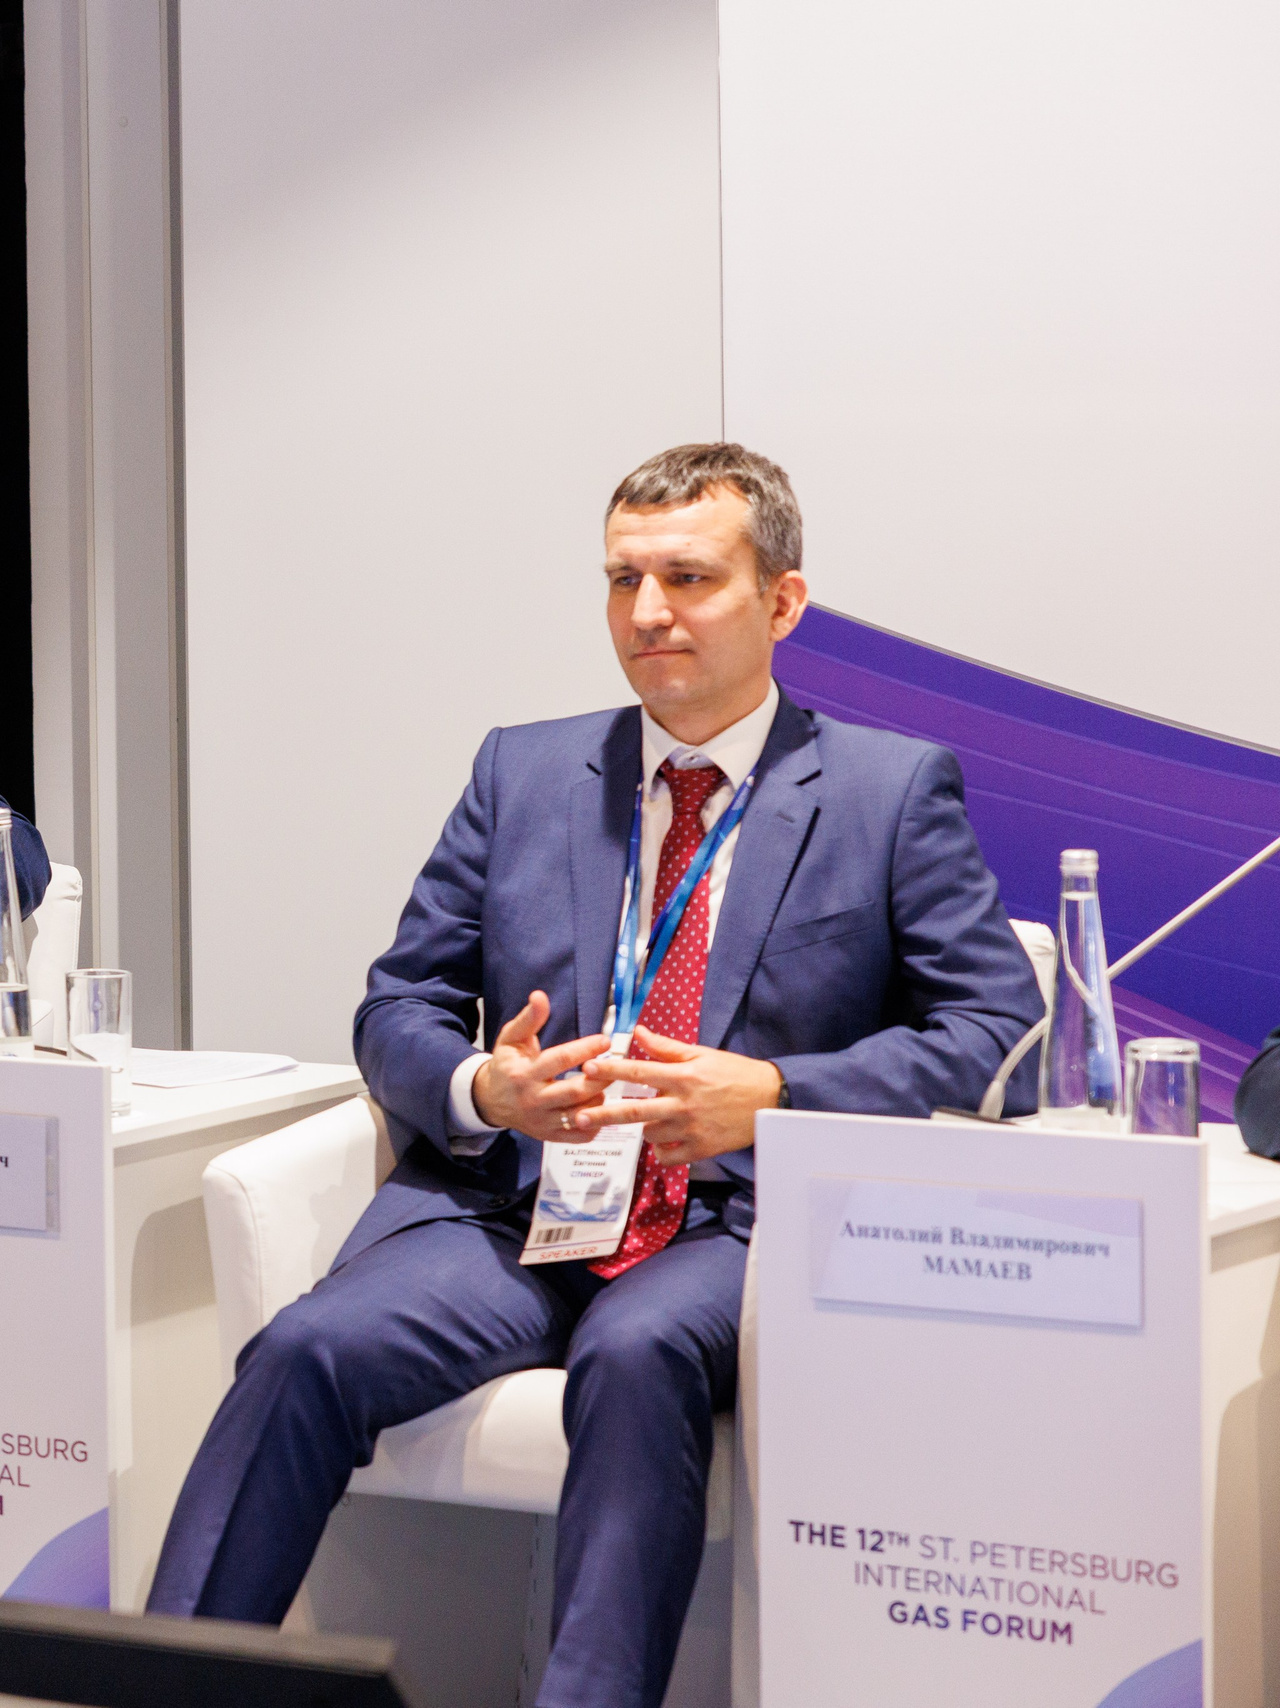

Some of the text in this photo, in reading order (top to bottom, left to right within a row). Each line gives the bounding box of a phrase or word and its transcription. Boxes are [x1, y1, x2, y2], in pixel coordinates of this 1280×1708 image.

[539, 1246, 598, 1260] SPEAKER
[839, 1219, 1111, 1258] Анатолий Владимирович
[922, 1254, 1032, 1281] МАМАЕВ
[788, 1520, 847, 1549] THE
[919, 1534, 959, 1563] ST.
[969, 1539, 1180, 1589] PETERSBURG
[853, 1561, 1106, 1616] INTERNATIONAL
[888, 1601, 1074, 1646] GAS FORUM
